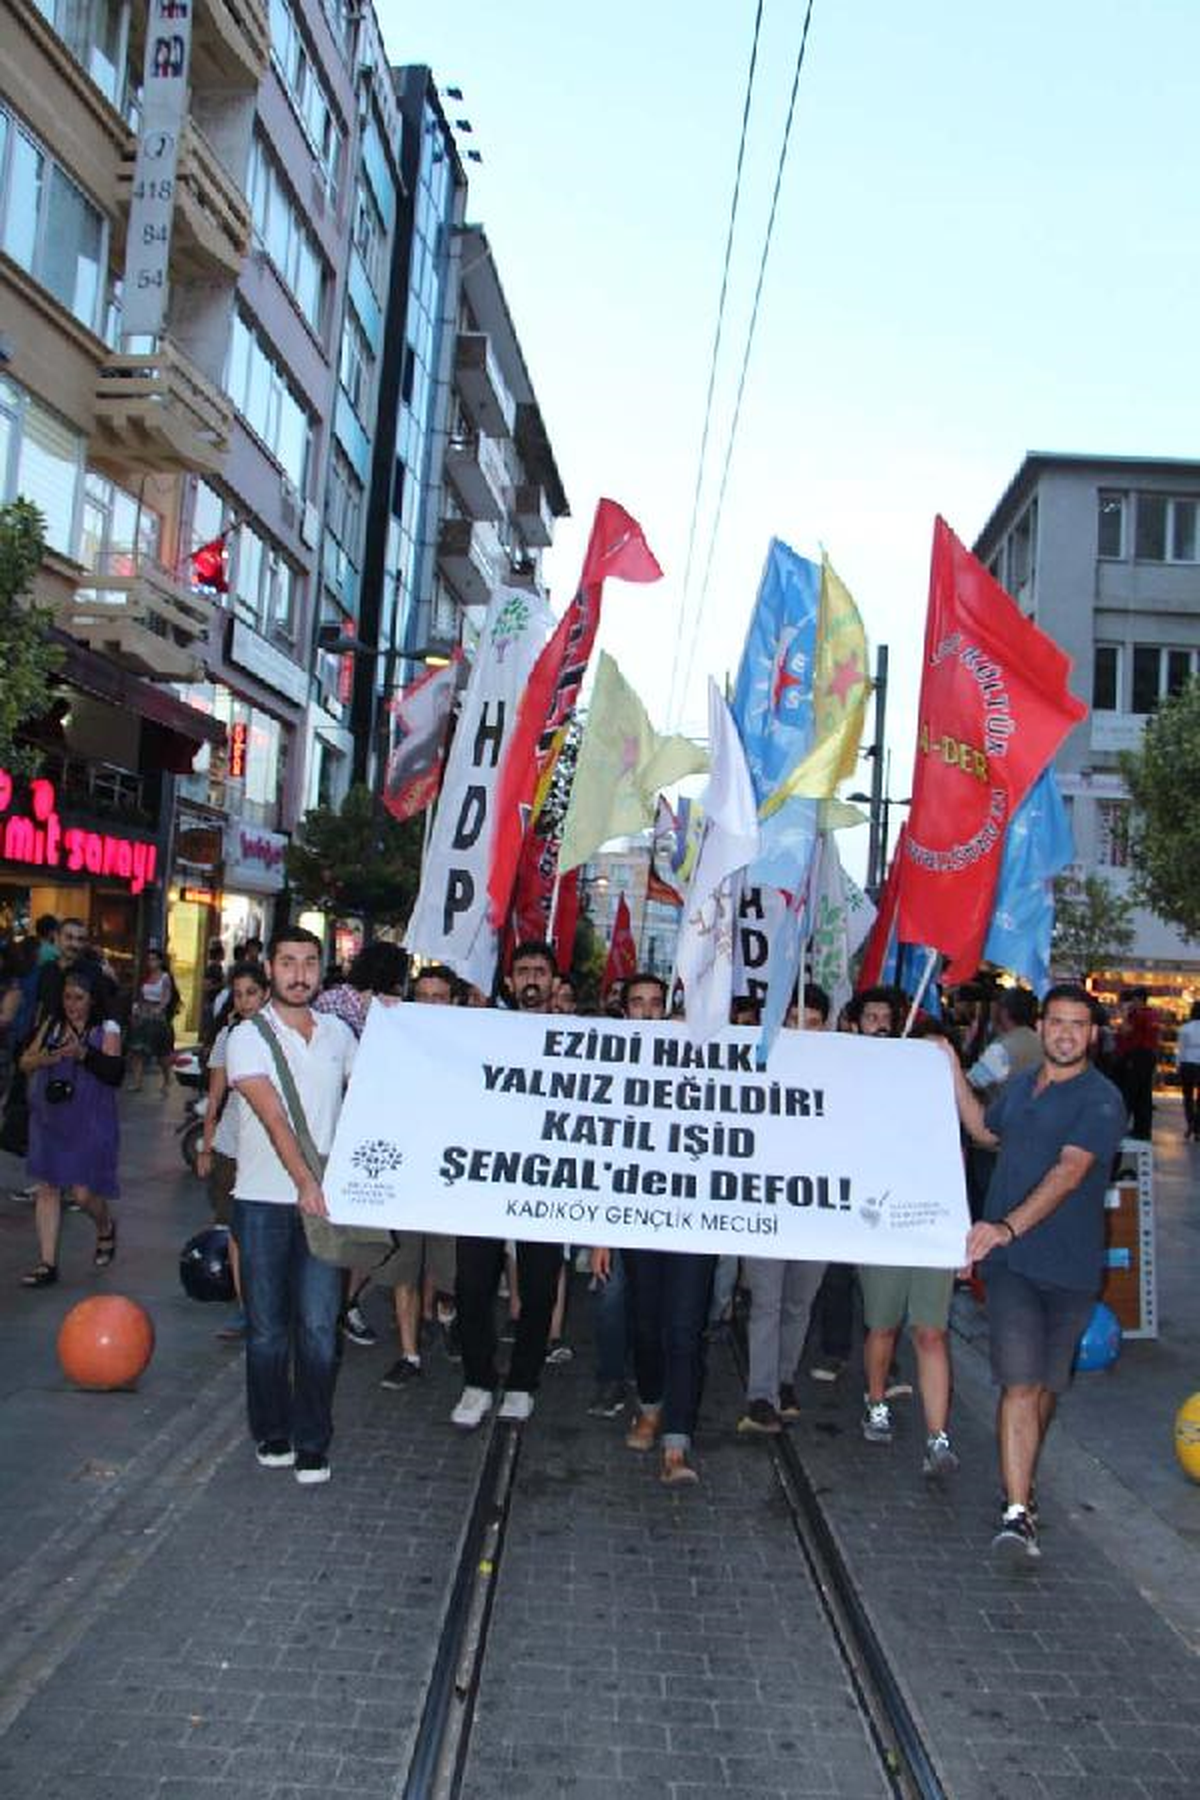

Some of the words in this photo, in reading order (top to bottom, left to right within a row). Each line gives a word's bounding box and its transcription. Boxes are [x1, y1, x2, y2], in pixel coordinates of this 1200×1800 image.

[142, 224, 167, 245] 84
[138, 269, 163, 289] 54
[442, 701, 506, 937] HDP
[543, 1027, 642, 1065] EZİDİ
[482, 1063, 614, 1105] YALNIZ
[623, 1074, 825, 1117] DEĞİLDİR!
[540, 1109, 655, 1152] KATİL
[667, 1121, 755, 1161] IŞİD
[439, 1145, 697, 1200] ŞENGAL'den
[709, 1170, 851, 1212] DEFOL!
[505, 1200, 599, 1224] KADIKÖY
